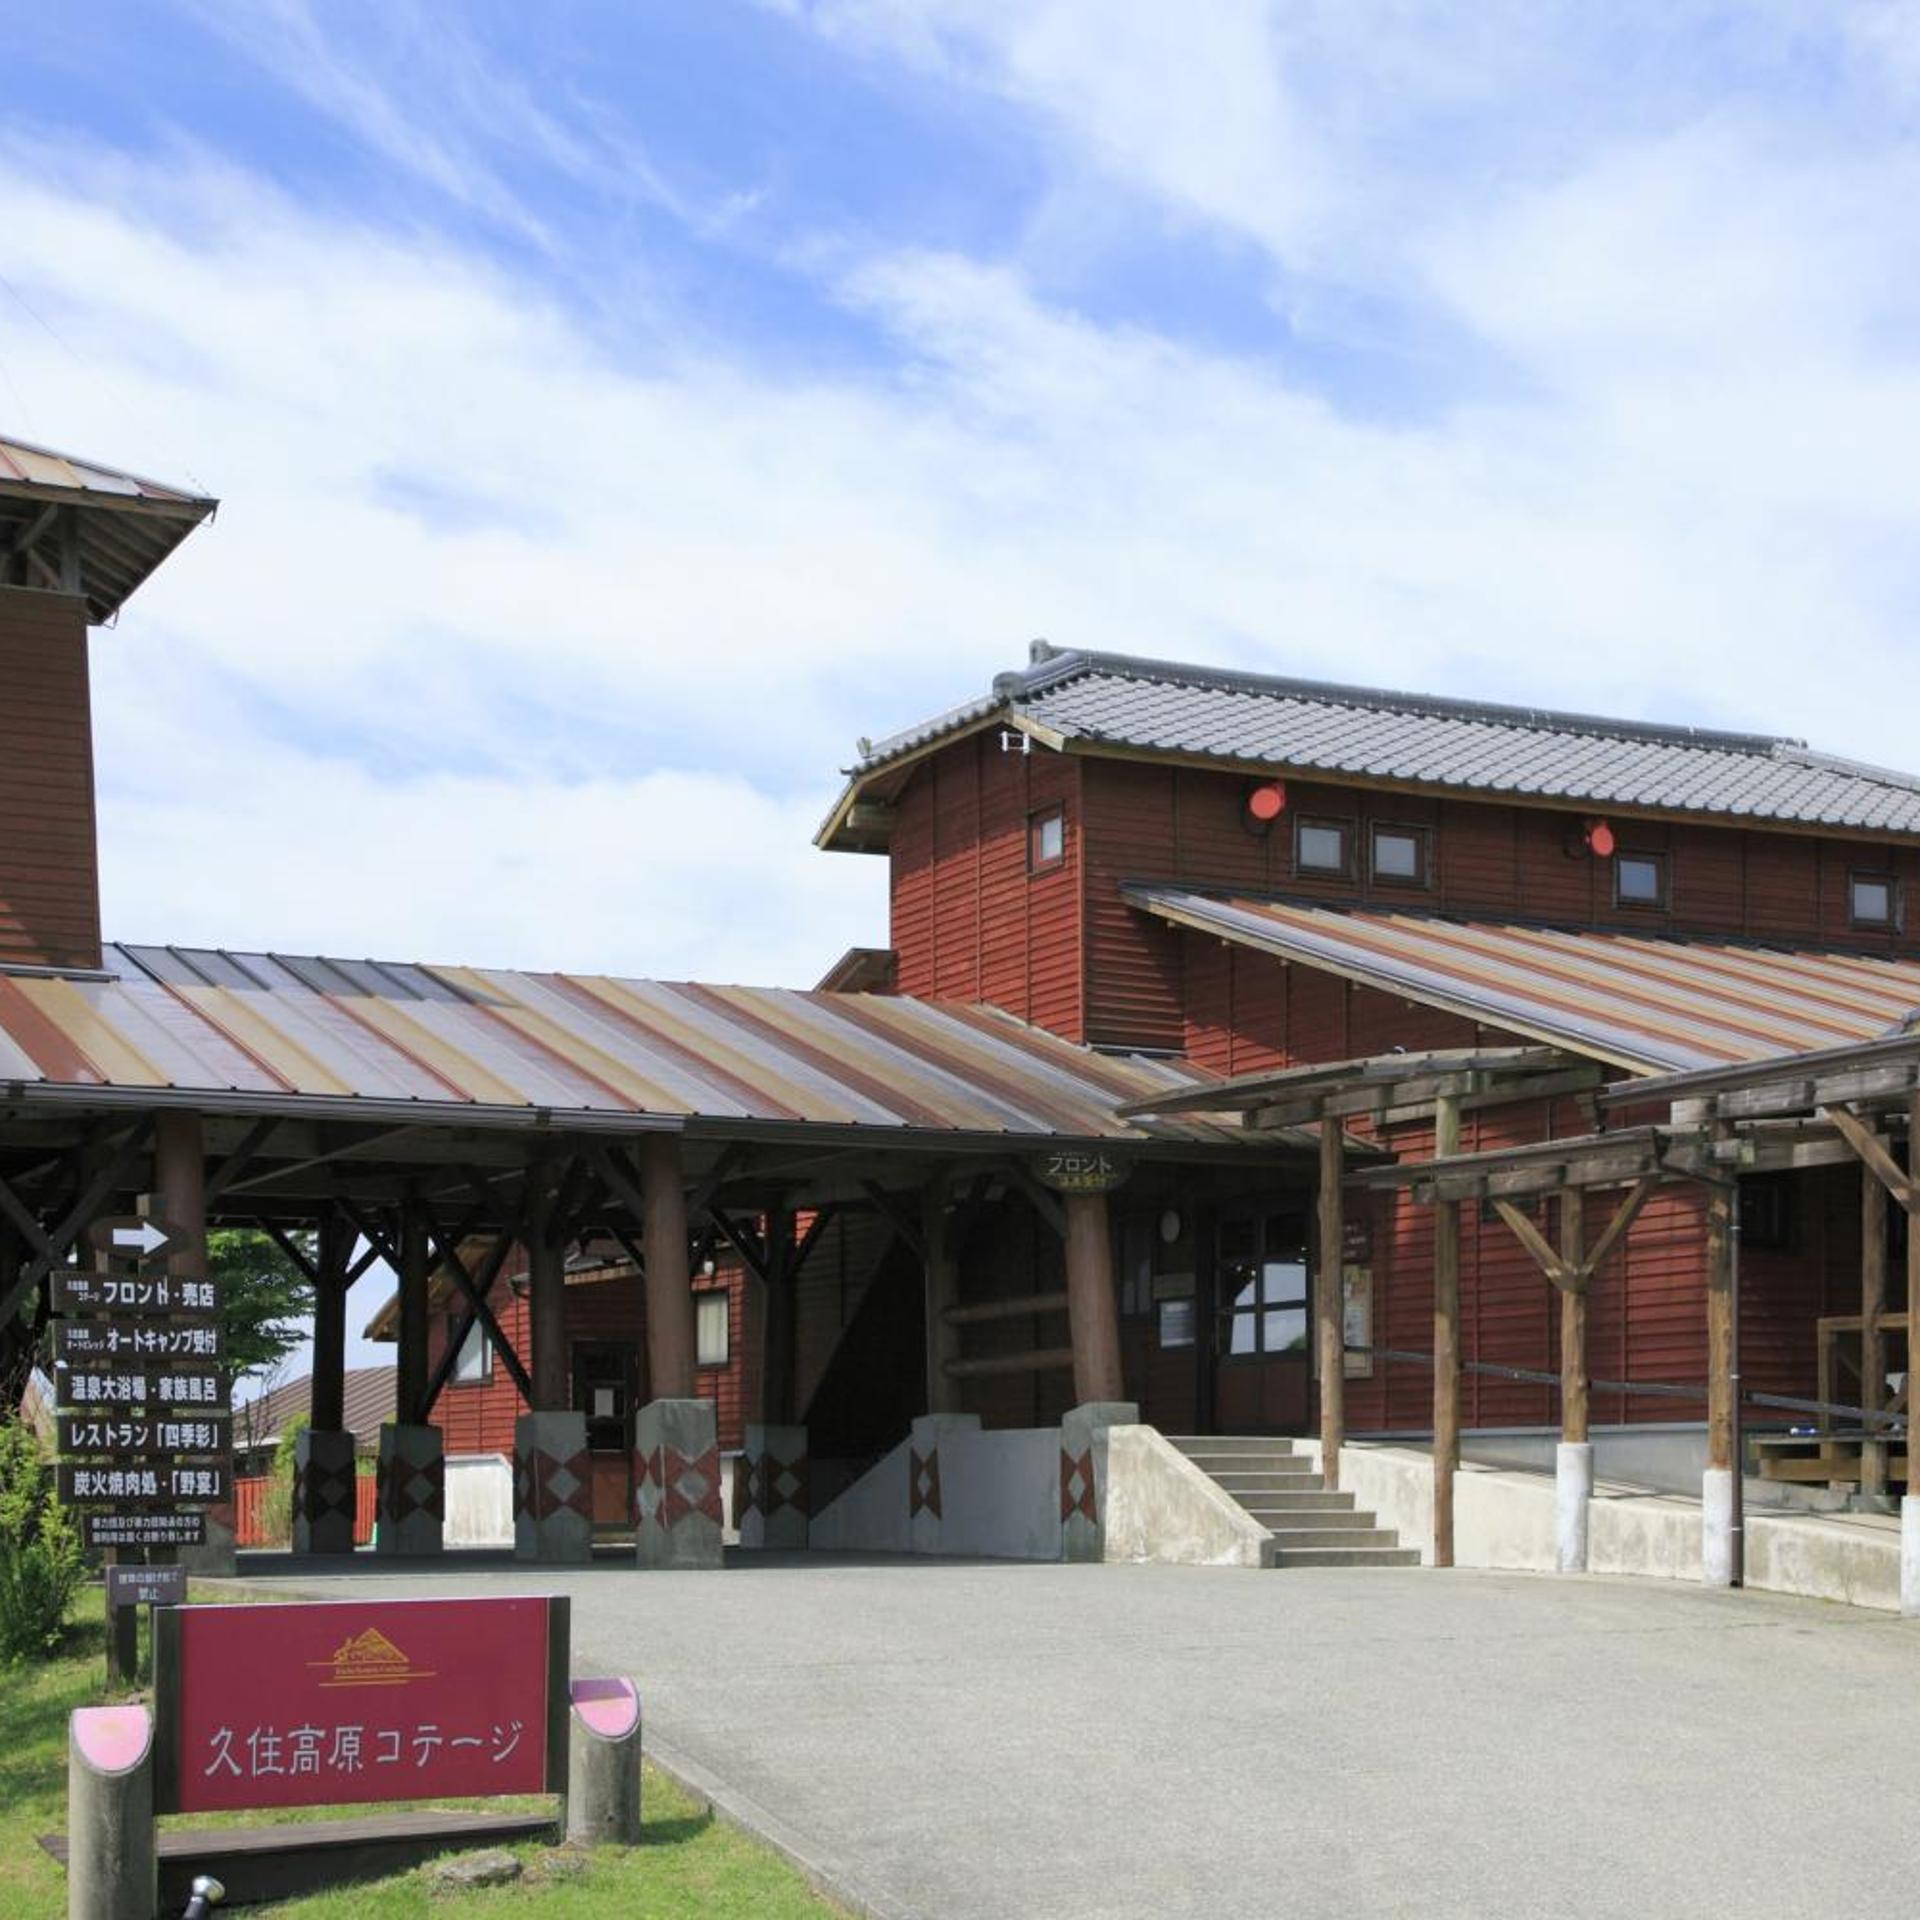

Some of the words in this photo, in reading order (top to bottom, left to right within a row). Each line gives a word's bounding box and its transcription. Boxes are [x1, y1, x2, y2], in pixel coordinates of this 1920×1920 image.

[1047, 1156, 1113, 1175] フロント
[103, 1280, 215, 1307] フロント・売店
[107, 1328, 217, 1354] オートキャンプ受付
[71, 1375, 217, 1401] 温泉大浴場・家族風呂
[71, 1422, 218, 1448] レストラン「四季彩」
[204, 1720, 524, 1777] 久住高原コテージ
